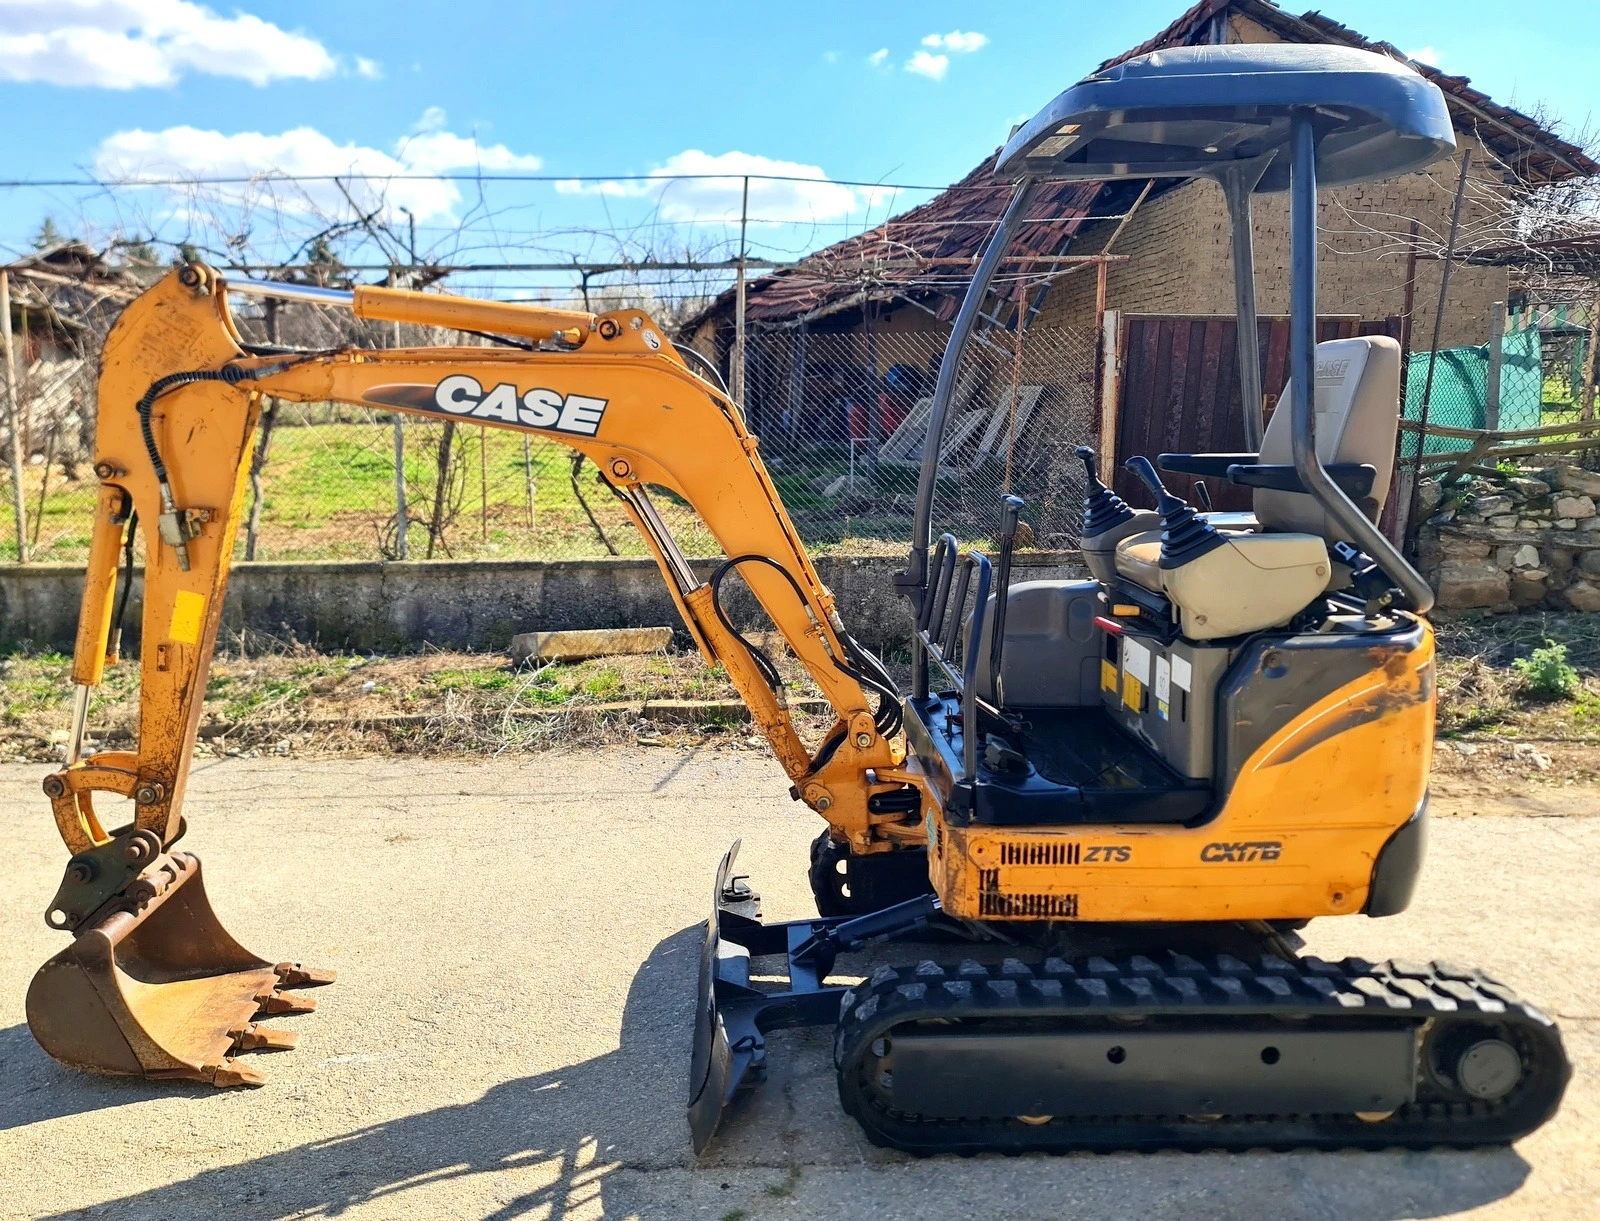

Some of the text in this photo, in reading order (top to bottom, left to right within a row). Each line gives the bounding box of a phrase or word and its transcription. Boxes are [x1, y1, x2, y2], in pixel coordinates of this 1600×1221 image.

[435, 375, 607, 434] CASE
[1083, 846, 1132, 862] ZTS
[1200, 842, 1282, 862] CX17B
